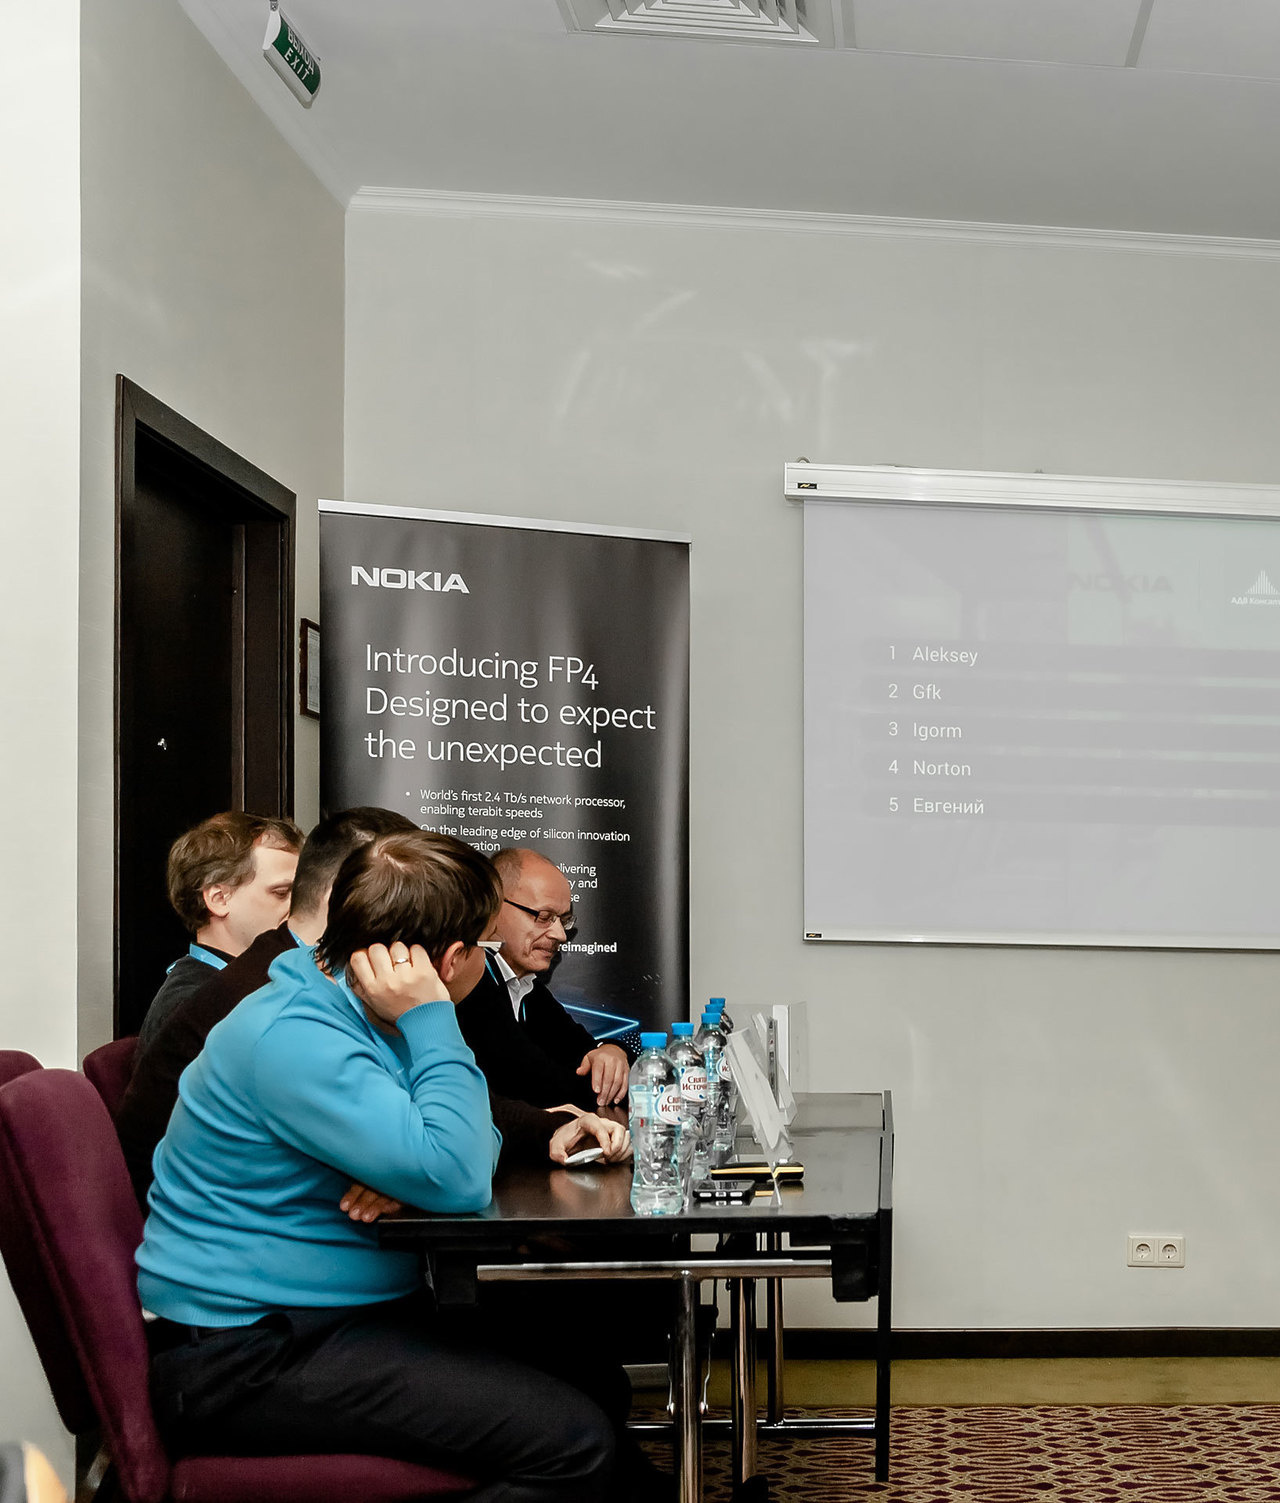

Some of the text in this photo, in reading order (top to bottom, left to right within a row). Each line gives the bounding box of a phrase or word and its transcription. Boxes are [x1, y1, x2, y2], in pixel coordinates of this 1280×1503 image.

[284, 47, 311, 81] EXIT
[351, 565, 471, 594] NOKIA
[889, 645, 895, 660] 1
[912, 646, 978, 667] Aleksey
[366, 644, 599, 691] Introducing FP4
[888, 683, 899, 698] 2
[913, 684, 942, 700] Gfk
[366, 687, 656, 734] Designed to expect
[888, 721, 899, 736] 3
[913, 723, 962, 741] Igorm
[364, 729, 602, 771] the unexpected
[888, 759, 899, 774] 4
[913, 760, 971, 776] Norton
[420, 789, 626, 809] World's first 2.4 Tb/s network processor,
[889, 797, 899, 812] 5
[913, 797, 984, 814] Евгений
[420, 804, 543, 820] enabling terabit speeds
[439, 824, 457, 836] the
[460, 825, 498, 840] leading
[500, 827, 527, 840] edge
[529, 827, 541, 838] of
[543, 828, 575, 839] silicon
[577, 829, 630, 842] innovation
[556, 863, 597, 877] livering
[578, 878, 598, 888] and
